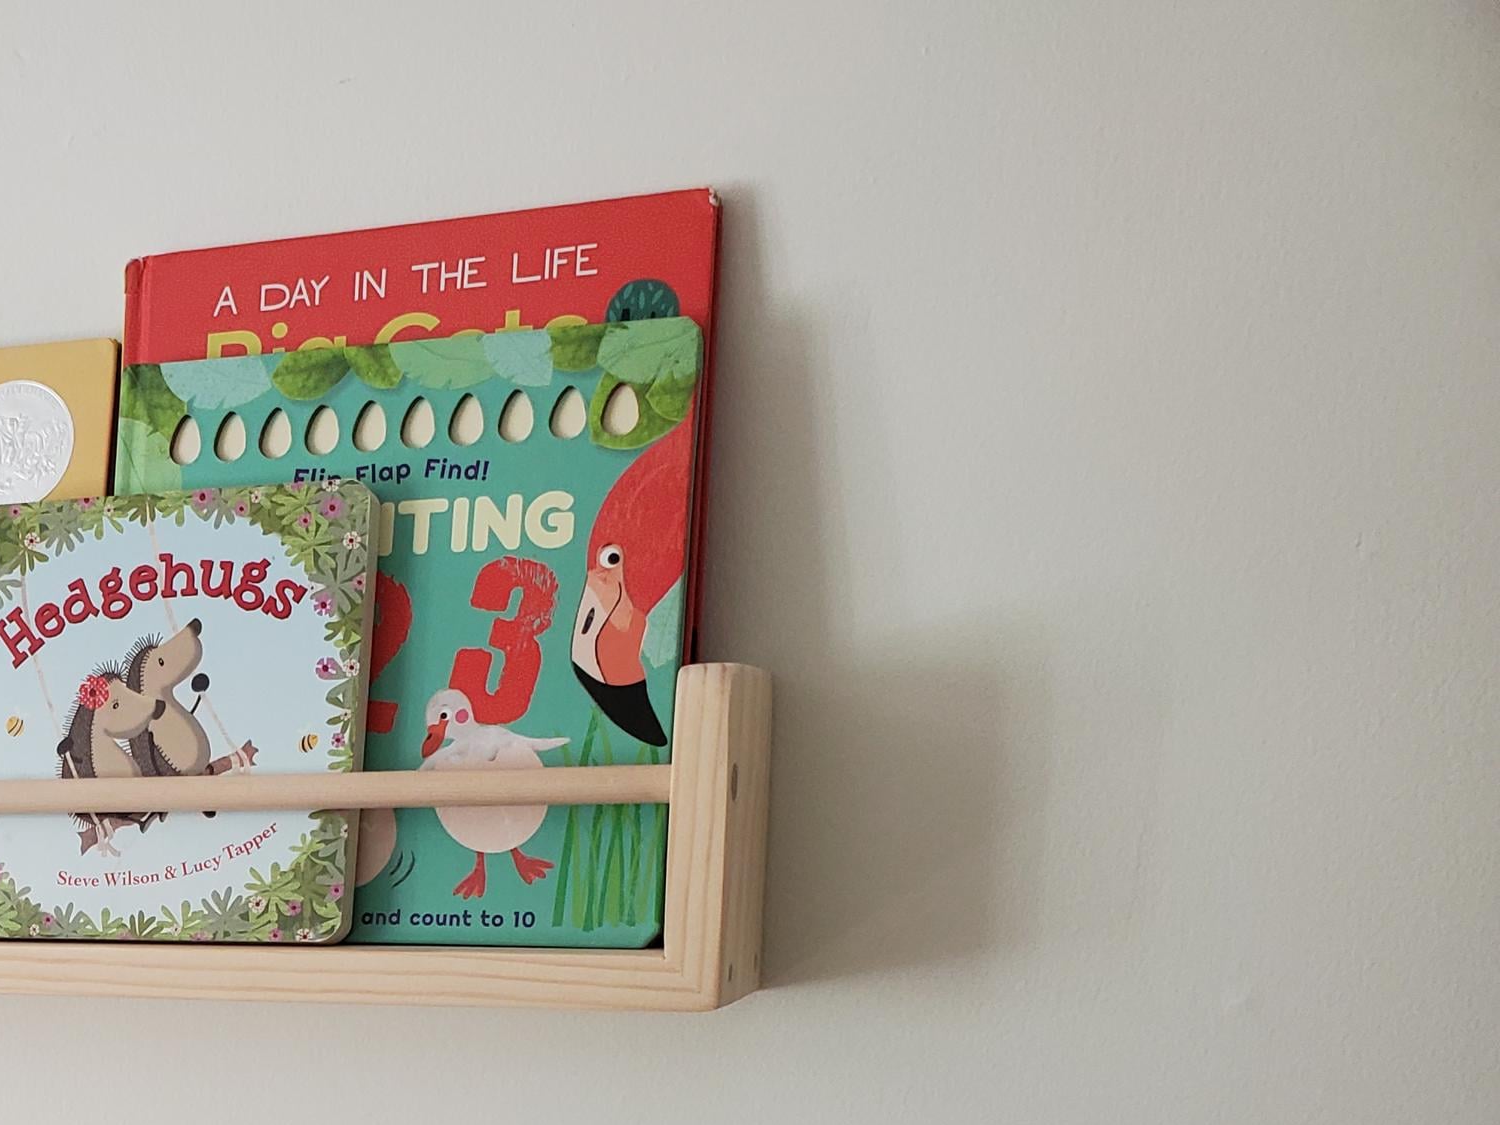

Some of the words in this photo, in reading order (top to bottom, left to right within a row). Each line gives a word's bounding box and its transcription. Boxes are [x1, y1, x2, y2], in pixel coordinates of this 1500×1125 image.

[214, 286, 237, 317] A
[260, 275, 329, 312] DAY
[353, 268, 387, 302] IN
[412, 256, 487, 293] THE
[512, 243, 598, 284] LIFE
[294, 468, 341, 482] Fli
[356, 463, 411, 484] Flap
[425, 458, 490, 481] Find!
[57, 870, 100, 887] Steve
[104, 870, 160, 887] Wilson
[164, 866, 177, 880] &
[181, 852, 221, 876] Lucy
[222, 822, 278, 861] Tapper
[361, 909, 401, 926] and
[409, 909, 472, 928] count
[480, 910, 504, 928] to
[514, 911, 536, 928] 10
